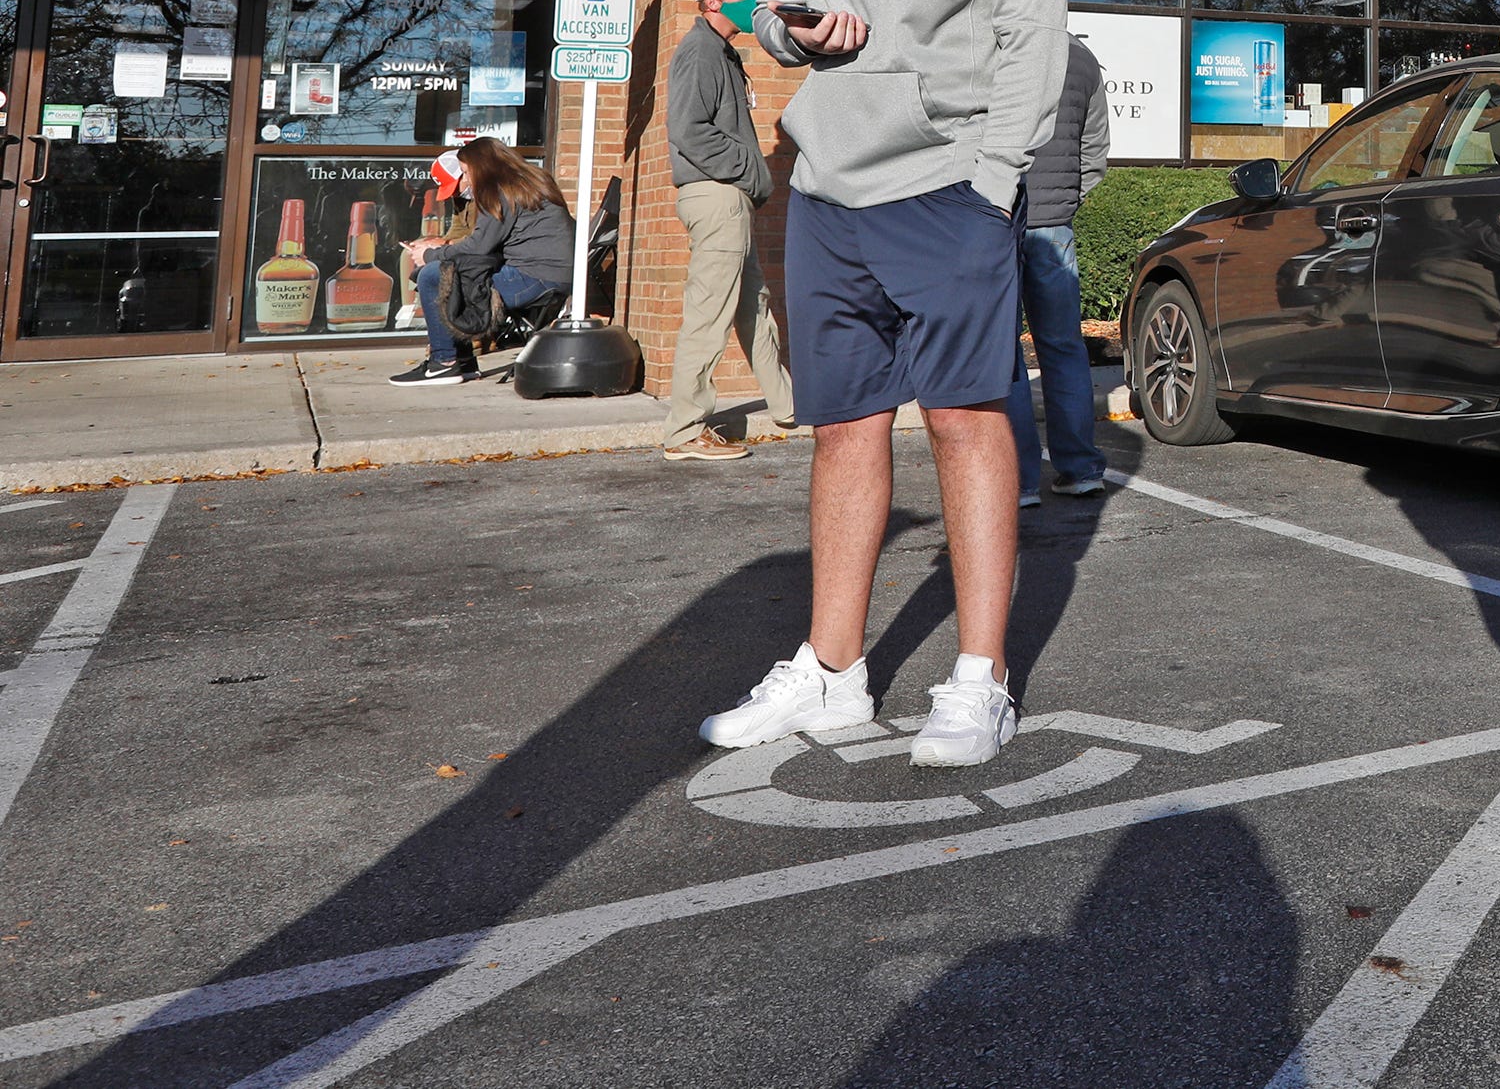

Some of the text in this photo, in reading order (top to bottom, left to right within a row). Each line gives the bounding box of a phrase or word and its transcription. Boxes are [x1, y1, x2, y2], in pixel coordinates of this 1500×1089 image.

[582, 3, 609, 17] VAN
[561, 21, 627, 35] ACCESSIBLE
[566, 51, 618, 63] $250 FINE
[1200, 55, 1243, 67] NO SUGAR,
[381, 60, 448, 72] SUNDAY
[568, 64, 614, 75] MINIMUM
[1195, 66, 1213, 76] JUST
[370, 76, 411, 90] 12PM
[423, 78, 458, 91] 5PM
[1104, 80, 1153, 95] ORD
[308, 167, 336, 180] The
